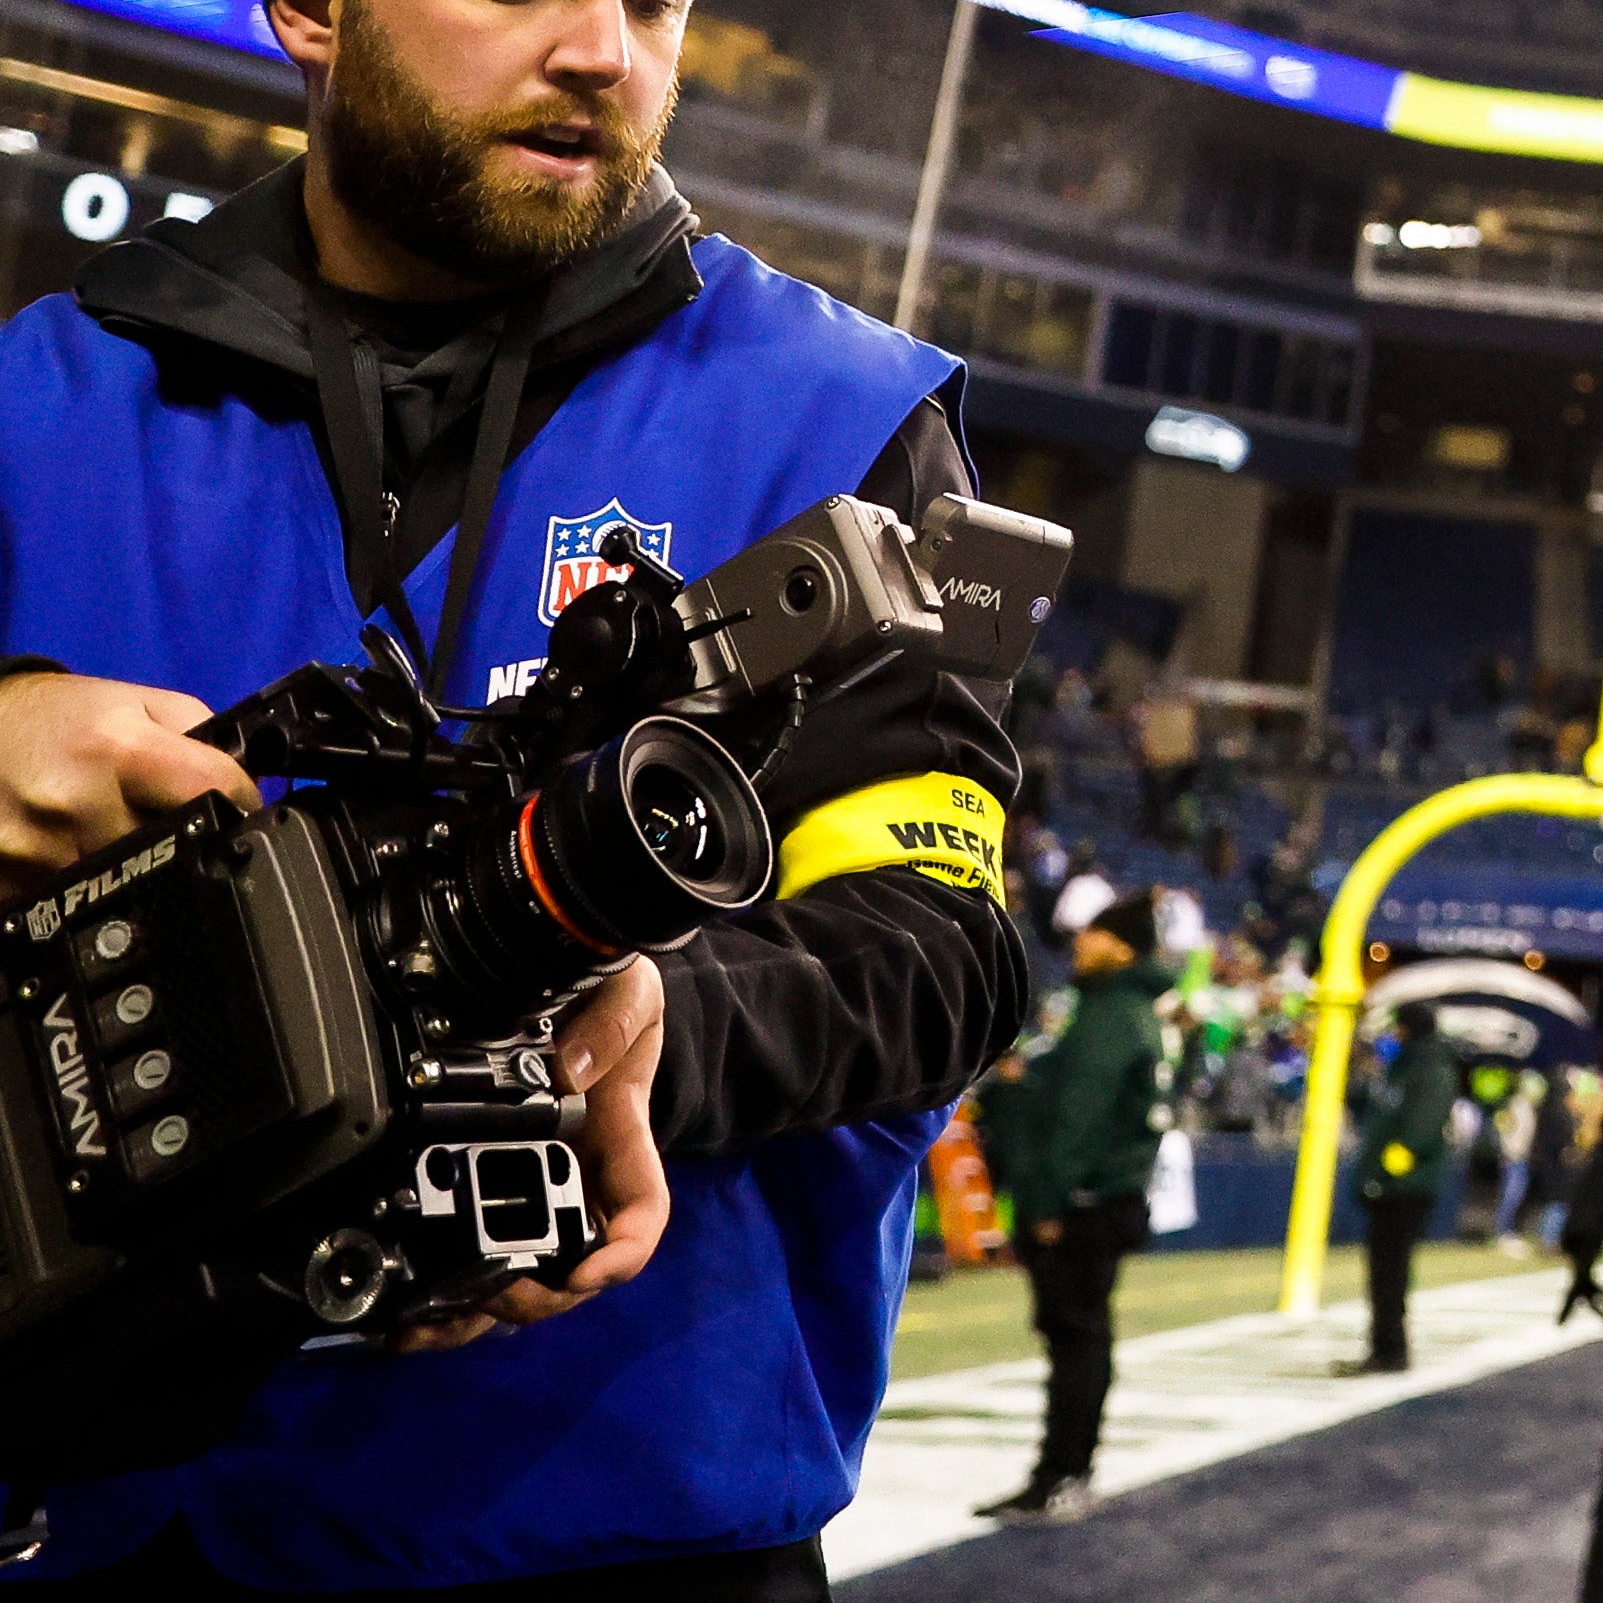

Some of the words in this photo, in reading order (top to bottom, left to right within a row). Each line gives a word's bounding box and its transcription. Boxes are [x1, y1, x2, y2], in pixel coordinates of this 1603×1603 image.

[937, 576, 1002, 612] AMIRA
[486, 656, 550, 707] NF
[951, 788, 986, 818] SEA
[63, 833, 177, 917] FILMS
[886, 820, 998, 880] WEEK
[42, 993, 107, 1156] AMIRA
